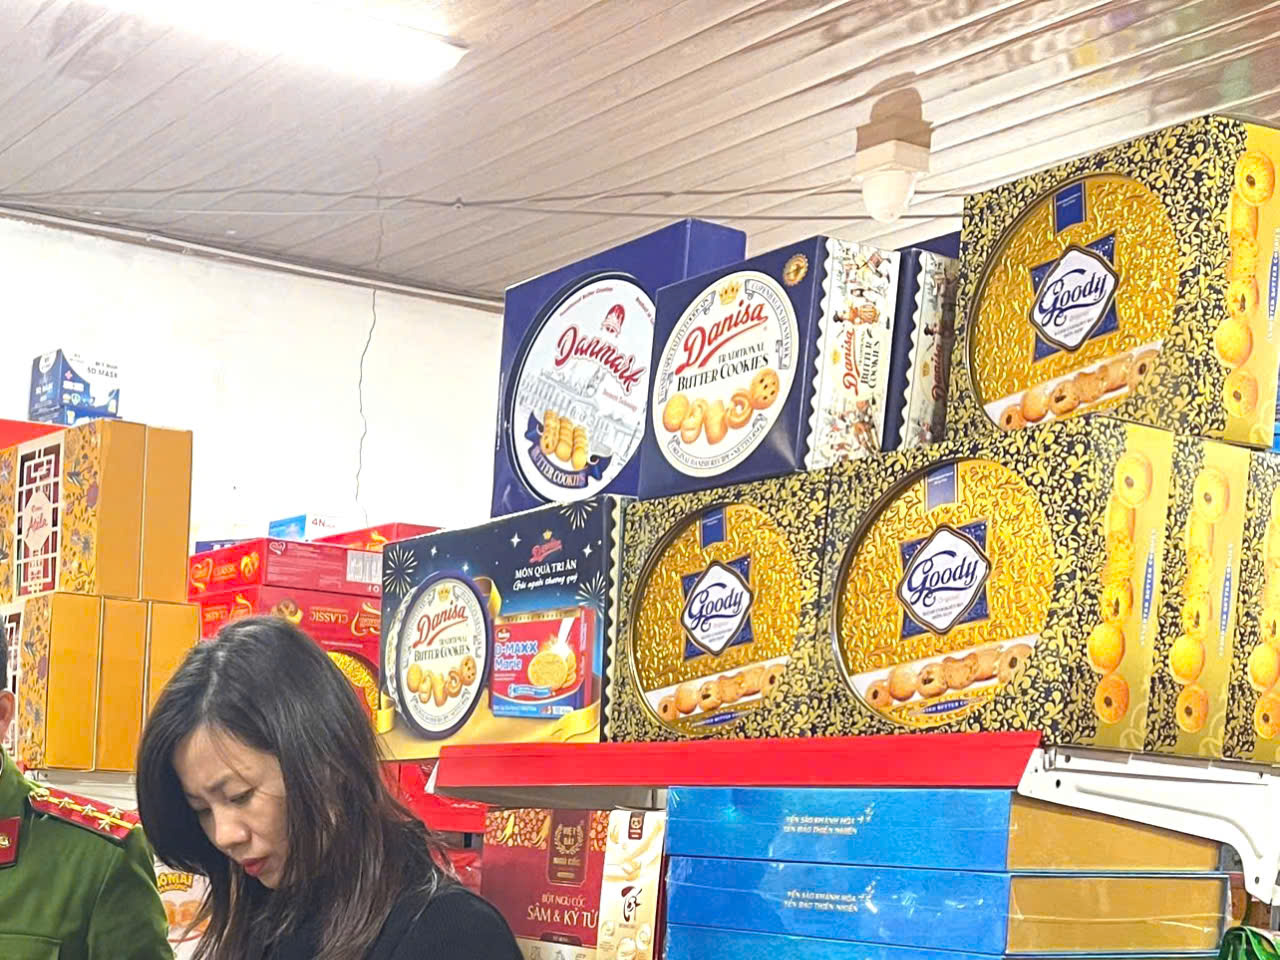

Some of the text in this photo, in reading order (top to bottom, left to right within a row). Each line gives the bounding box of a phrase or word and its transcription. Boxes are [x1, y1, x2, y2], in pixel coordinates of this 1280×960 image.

[1038, 267, 1108, 326] Goody
[675, 300, 768, 375] Danisa
[677, 354, 769, 392] BUTTER COOKIES
[907, 550, 979, 607] Goody
[413, 600, 468, 648] Danisa
[688, 582, 744, 633] Goody
